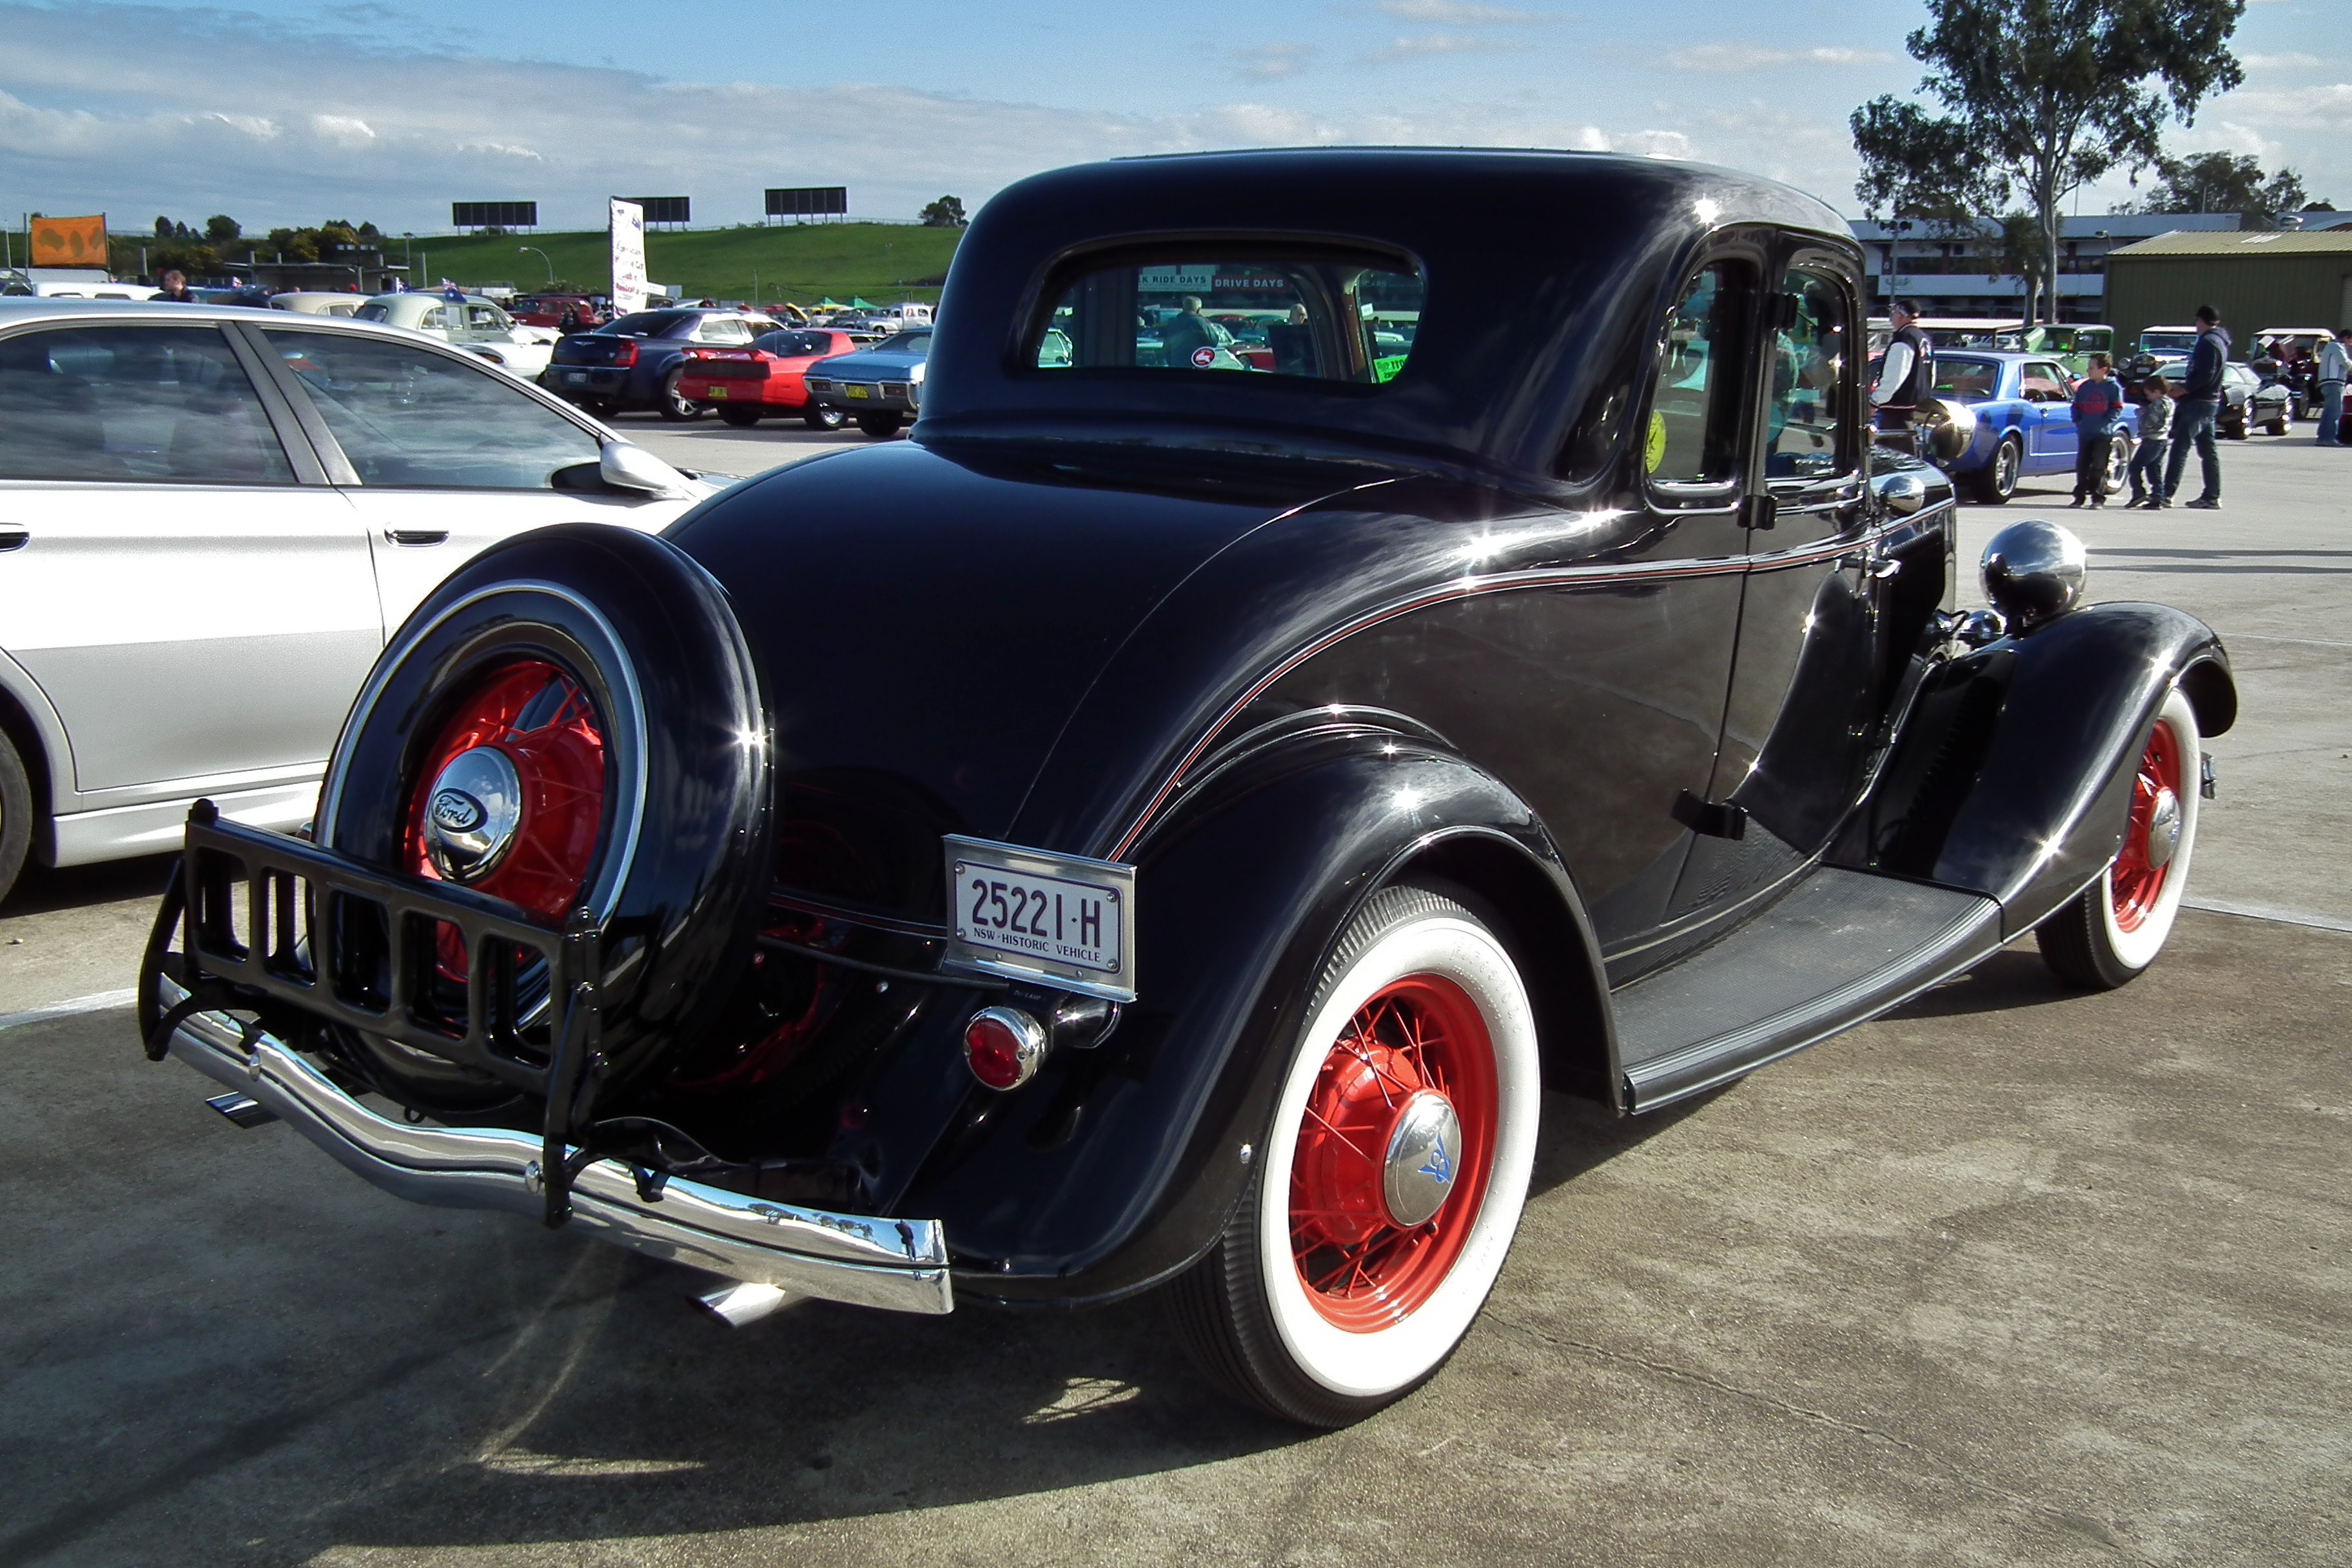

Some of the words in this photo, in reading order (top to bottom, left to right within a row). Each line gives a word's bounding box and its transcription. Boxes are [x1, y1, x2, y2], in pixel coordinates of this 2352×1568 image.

[1179, 275, 1207, 284] DAYS
[1215, 279, 1250, 288] DRIVE
[1253, 279, 1284, 288] DAYS
[435, 794, 472, 824] Ford
[974, 927, 995, 941] NSW
[1002, 934, 1050, 952] HISTORIC
[1056, 945, 1101, 963] VEHICLE
